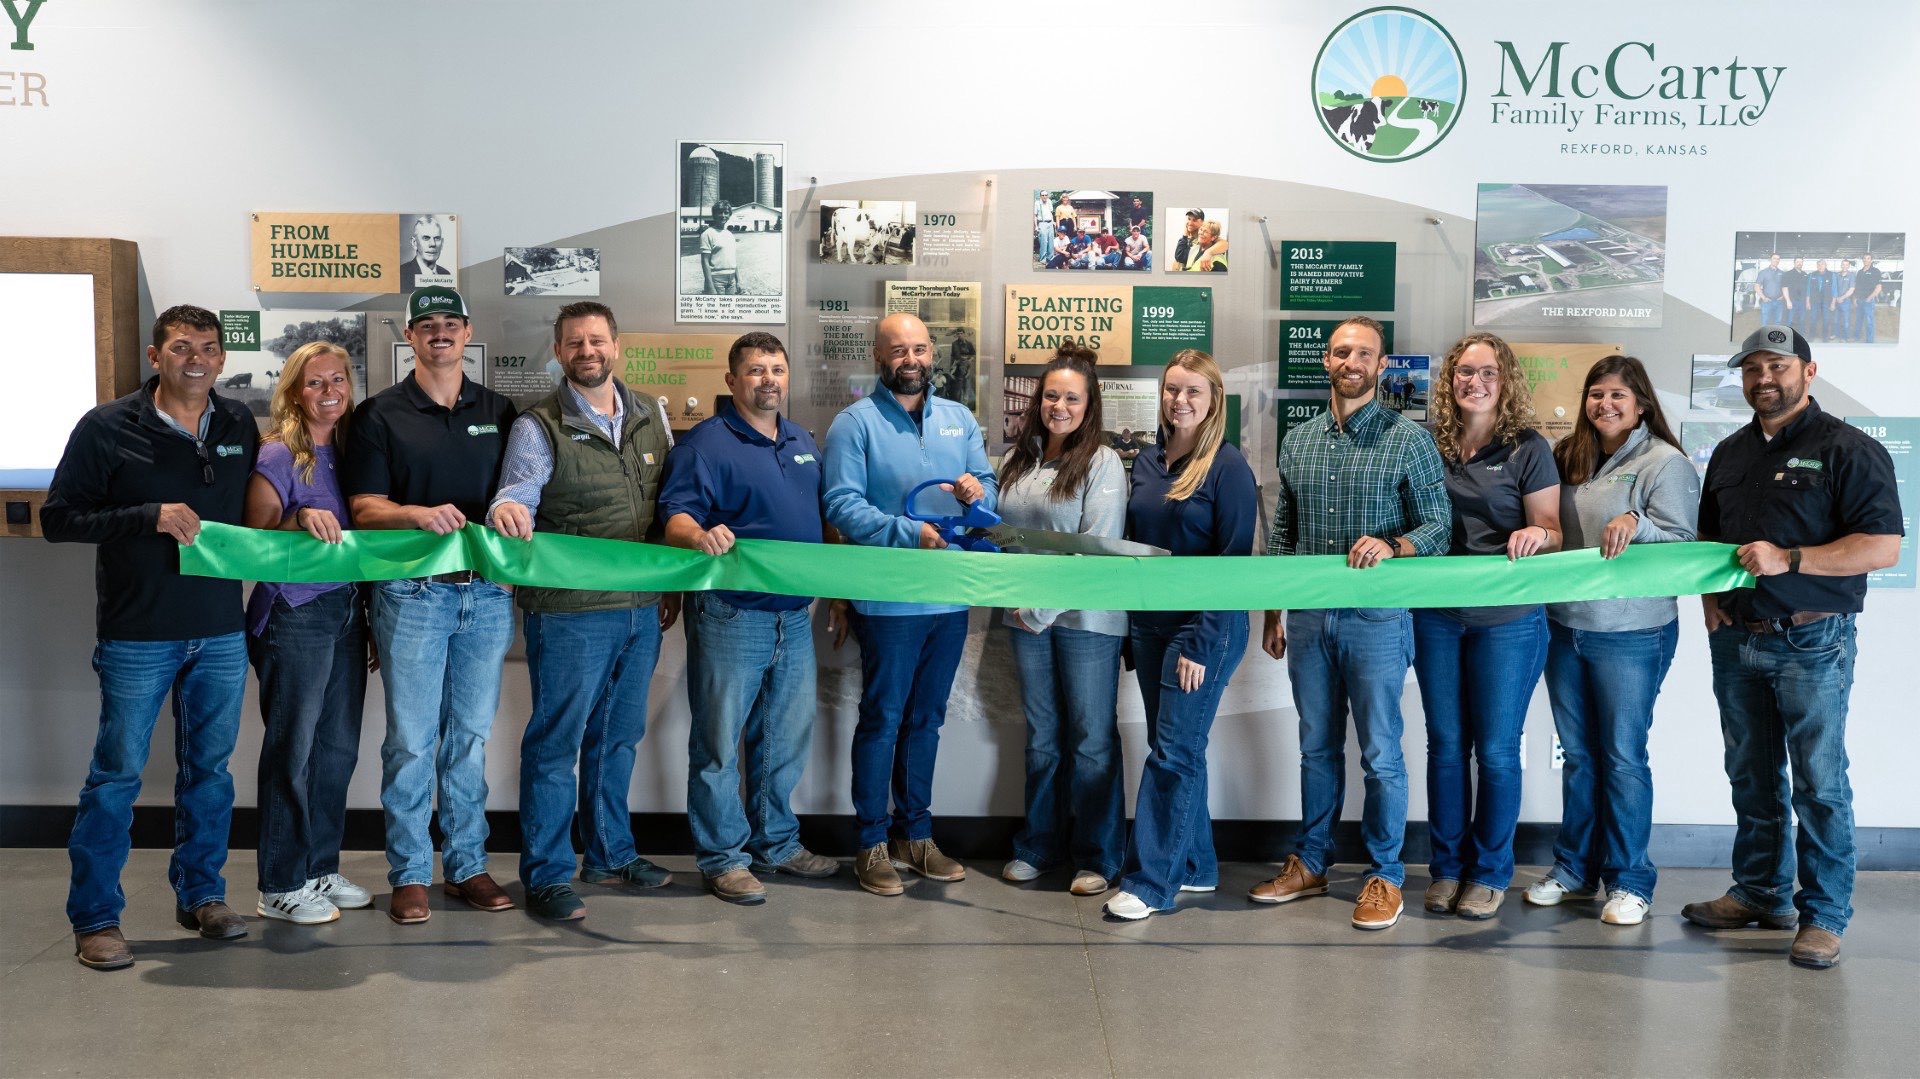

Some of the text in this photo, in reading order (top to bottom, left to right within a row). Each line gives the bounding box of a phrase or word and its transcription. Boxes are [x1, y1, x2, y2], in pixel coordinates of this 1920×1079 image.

[1490, 40, 1787, 120] McCarty
[1491, 102, 1760, 132] Family Farms, LLC
[1560, 143, 1708, 156] REXFORD, KANSAS
[923, 214, 956, 226] 1970
[270, 225, 330, 240] FROM
[271, 243, 358, 260] HUMBLE
[1290, 248, 1323, 260] 2013
[271, 262, 382, 279] BEGININGS
[820, 300, 850, 311] 1981
[1017, 296, 1123, 313] PLANTING
[1142, 306, 1174, 318] 1999
[1542, 307, 1652, 318] THE REXFORD DAIRY
[1017, 316, 1114, 332] ROOTS IN
[224, 332, 256, 344] 1914
[1288, 326, 1322, 338] 2014
[624, 347, 714, 360] CHALLENGE
[494, 356, 527, 368] 1927
[625, 360, 657, 372] AND
[1519, 356, 1568, 368] KING A
[624, 373, 687, 385] CHANGE
[1528, 370, 1558, 380] ERN
[1102, 382, 1134, 392] JOURNAL
[1287, 406, 1320, 418] 2017
[940, 428, 964, 437] Cargill
